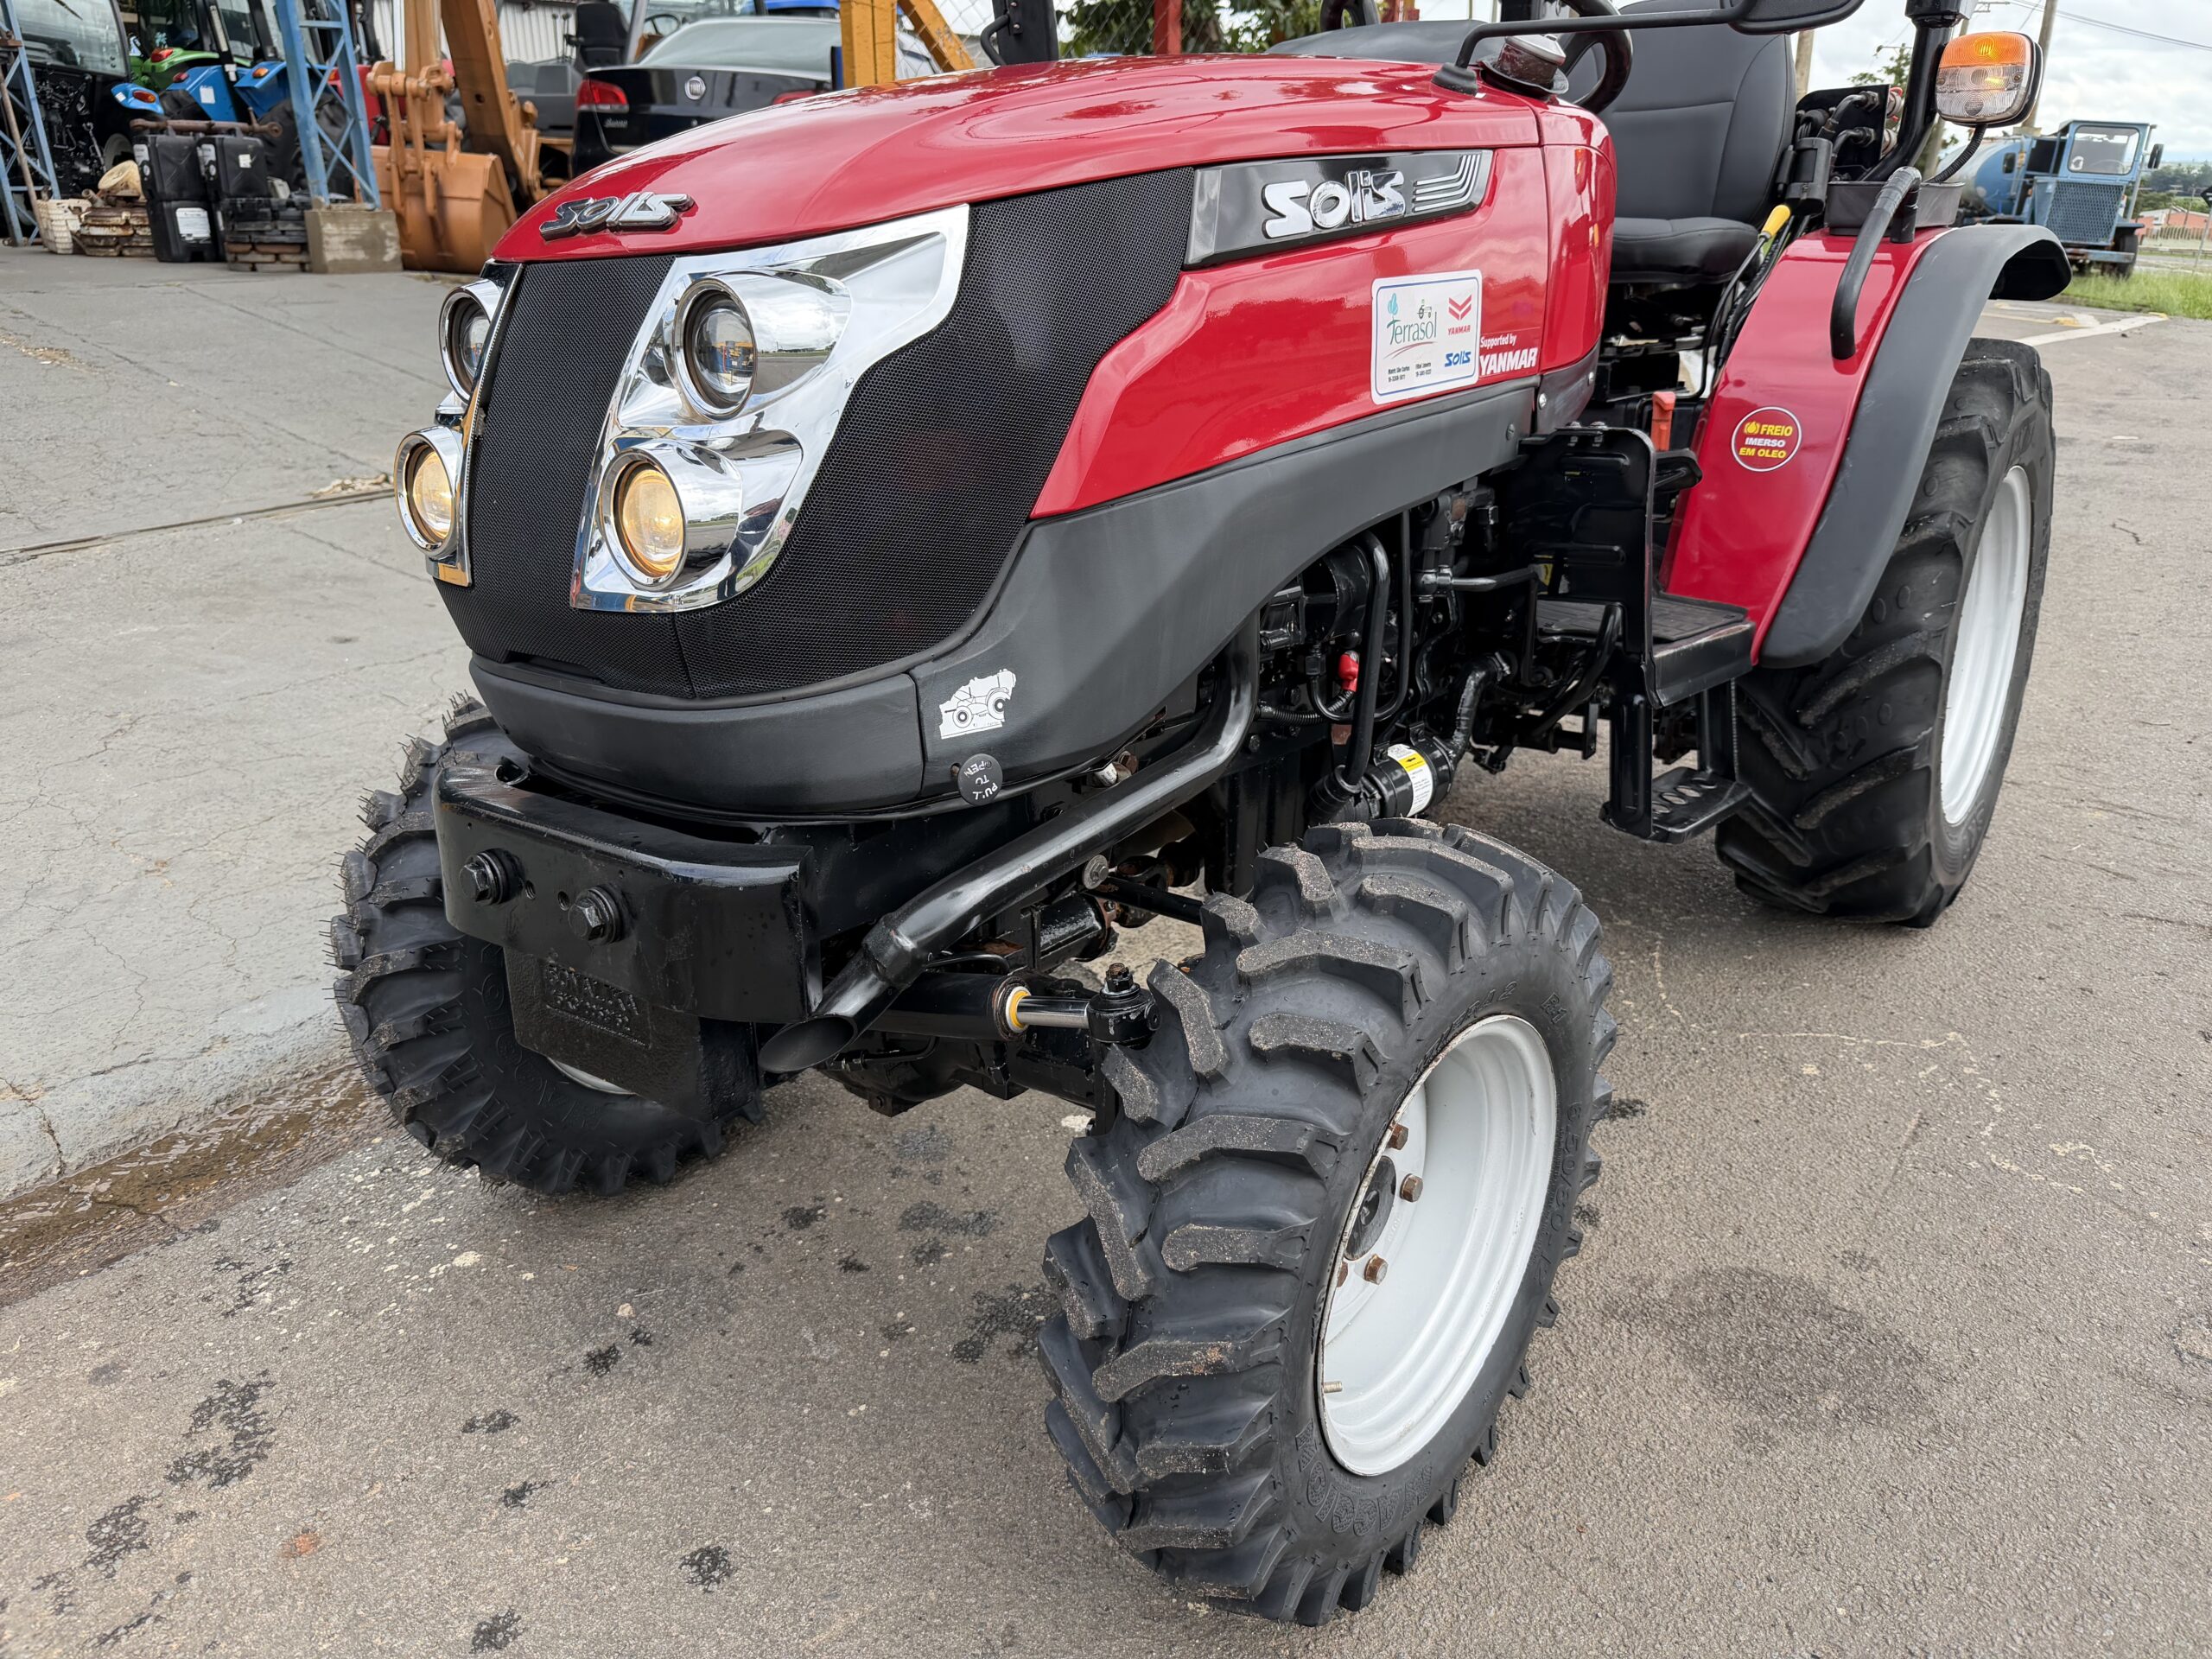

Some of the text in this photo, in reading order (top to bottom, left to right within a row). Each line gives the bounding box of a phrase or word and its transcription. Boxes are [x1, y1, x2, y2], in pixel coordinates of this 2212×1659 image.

[1387, 311, 1438, 345] Terrasol
[1447, 325, 1471, 336] YANMAR
[1480, 334, 1517, 350] Supported by
[1479, 347, 1538, 376] YANMAR
[1759, 424, 1793, 436] FREIO
[1745, 437, 1786, 448] IMERSO
[1739, 447, 1787, 459] EM OLEO
[975, 774, 990, 785] TO
